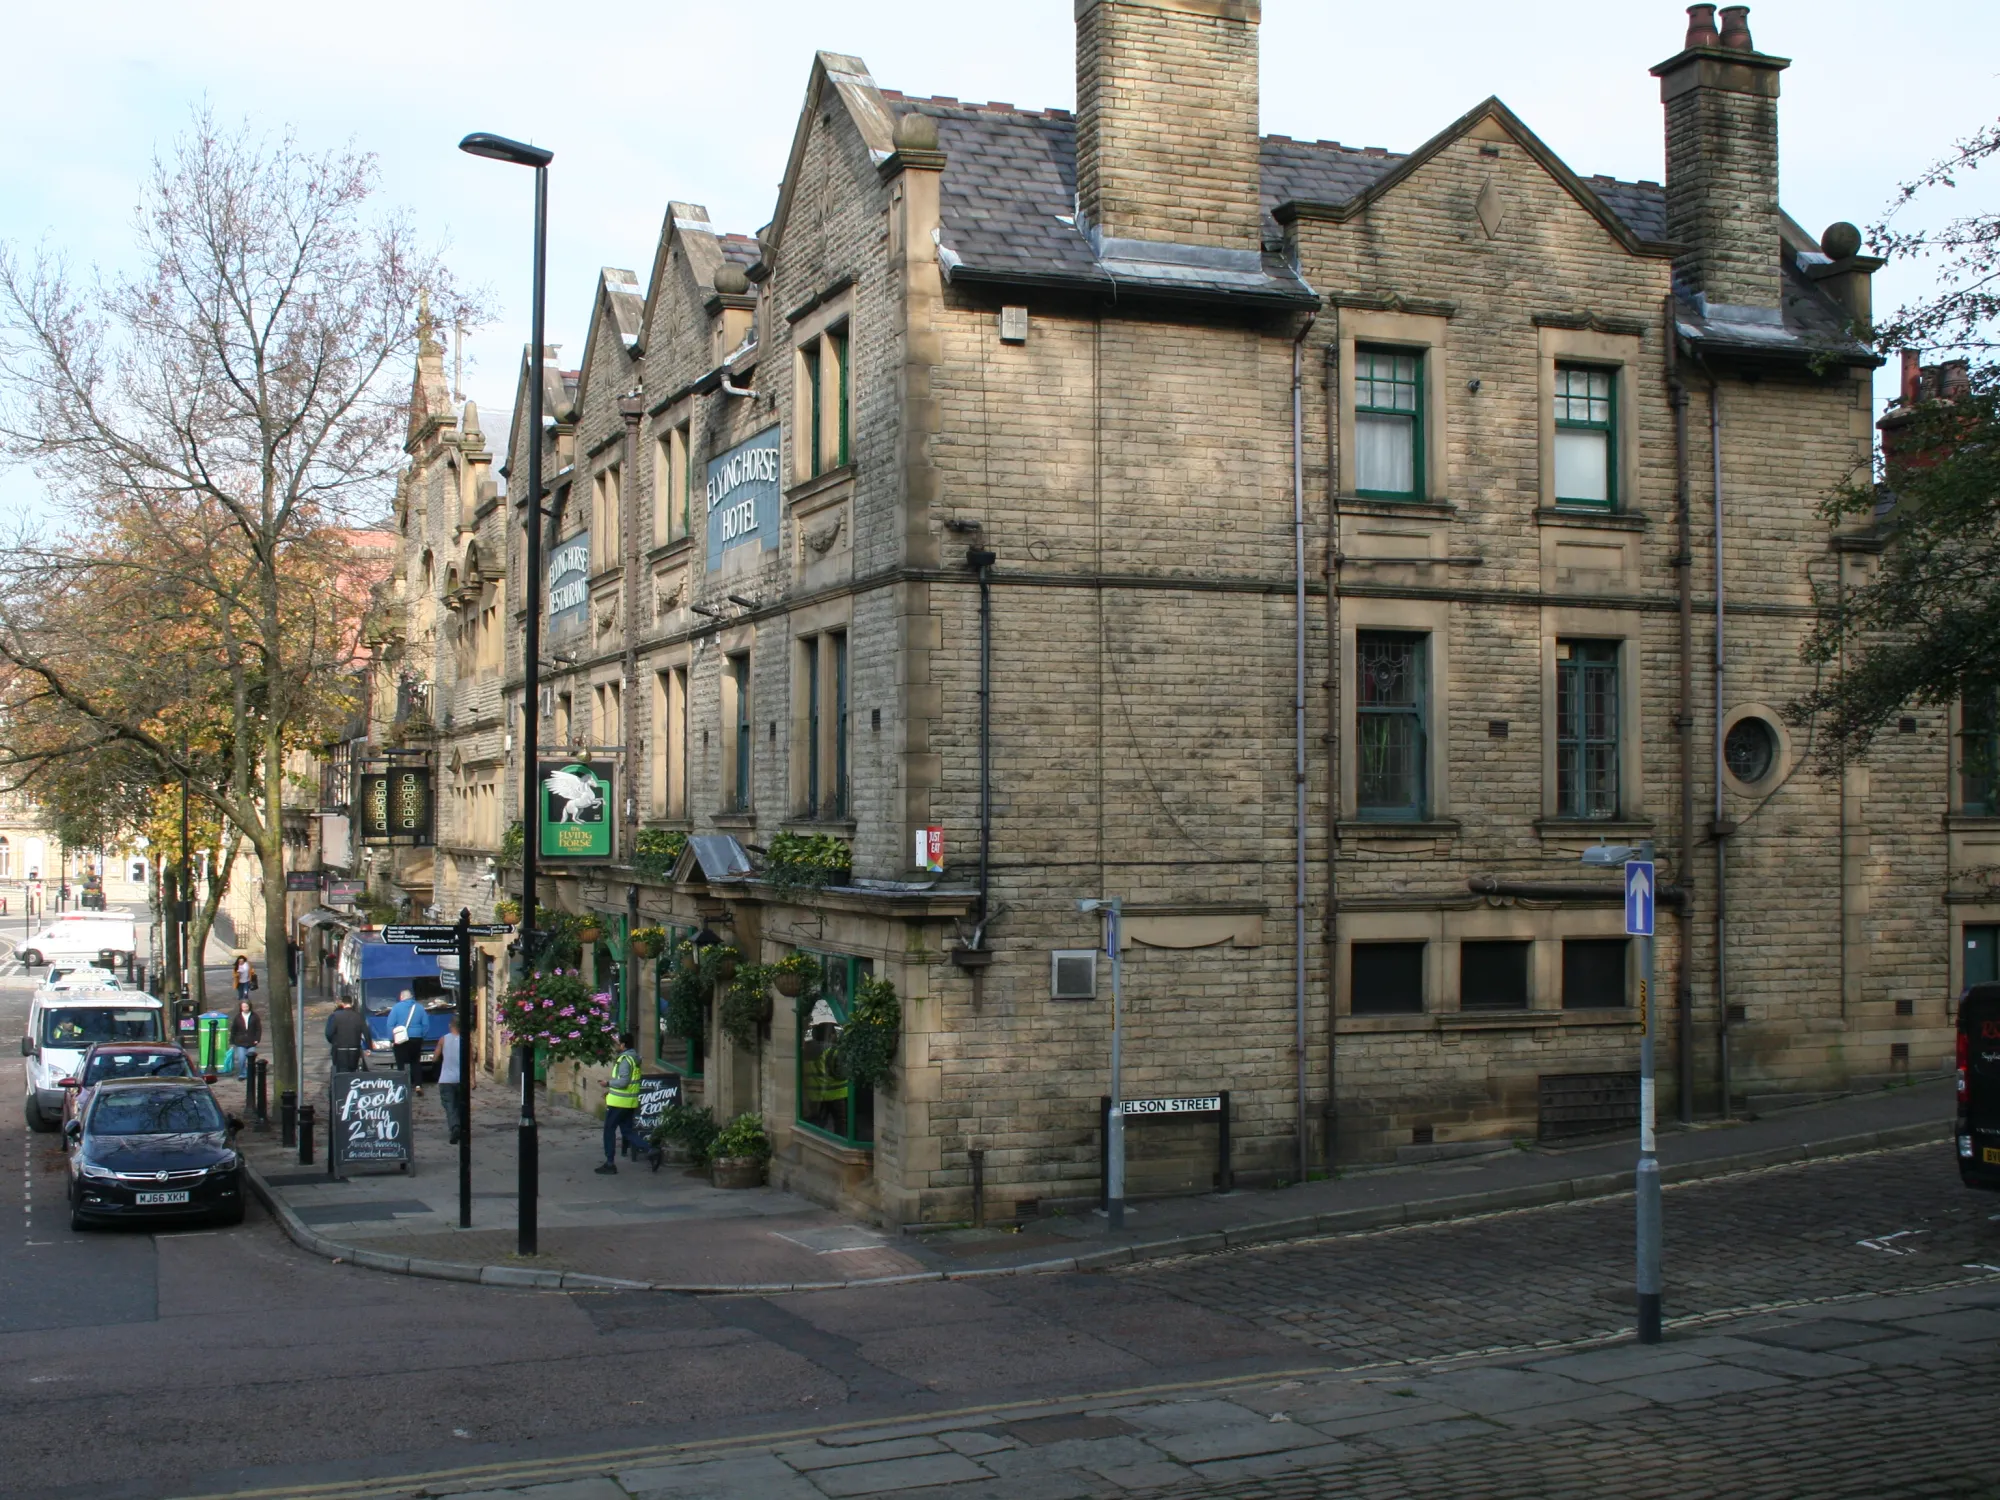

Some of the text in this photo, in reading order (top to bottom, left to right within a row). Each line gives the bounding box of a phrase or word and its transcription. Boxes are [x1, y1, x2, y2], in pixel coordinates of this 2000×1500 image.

[707, 448, 779, 513] FLYING HORSE
[722, 498, 759, 542] HOTEL
[568, 546, 588, 573] HORSE
[929, 831, 941, 844] JUST
[931, 842, 941, 853] EAT
[350, 1077, 394, 1094] Serving
[638, 1086, 678, 1105] FUNCTION
[1121, 1098, 1217, 1113] ELSON STREET
[348, 1120, 366, 1141] 2
[140, 1192, 186, 1203] MJ66 XKH
